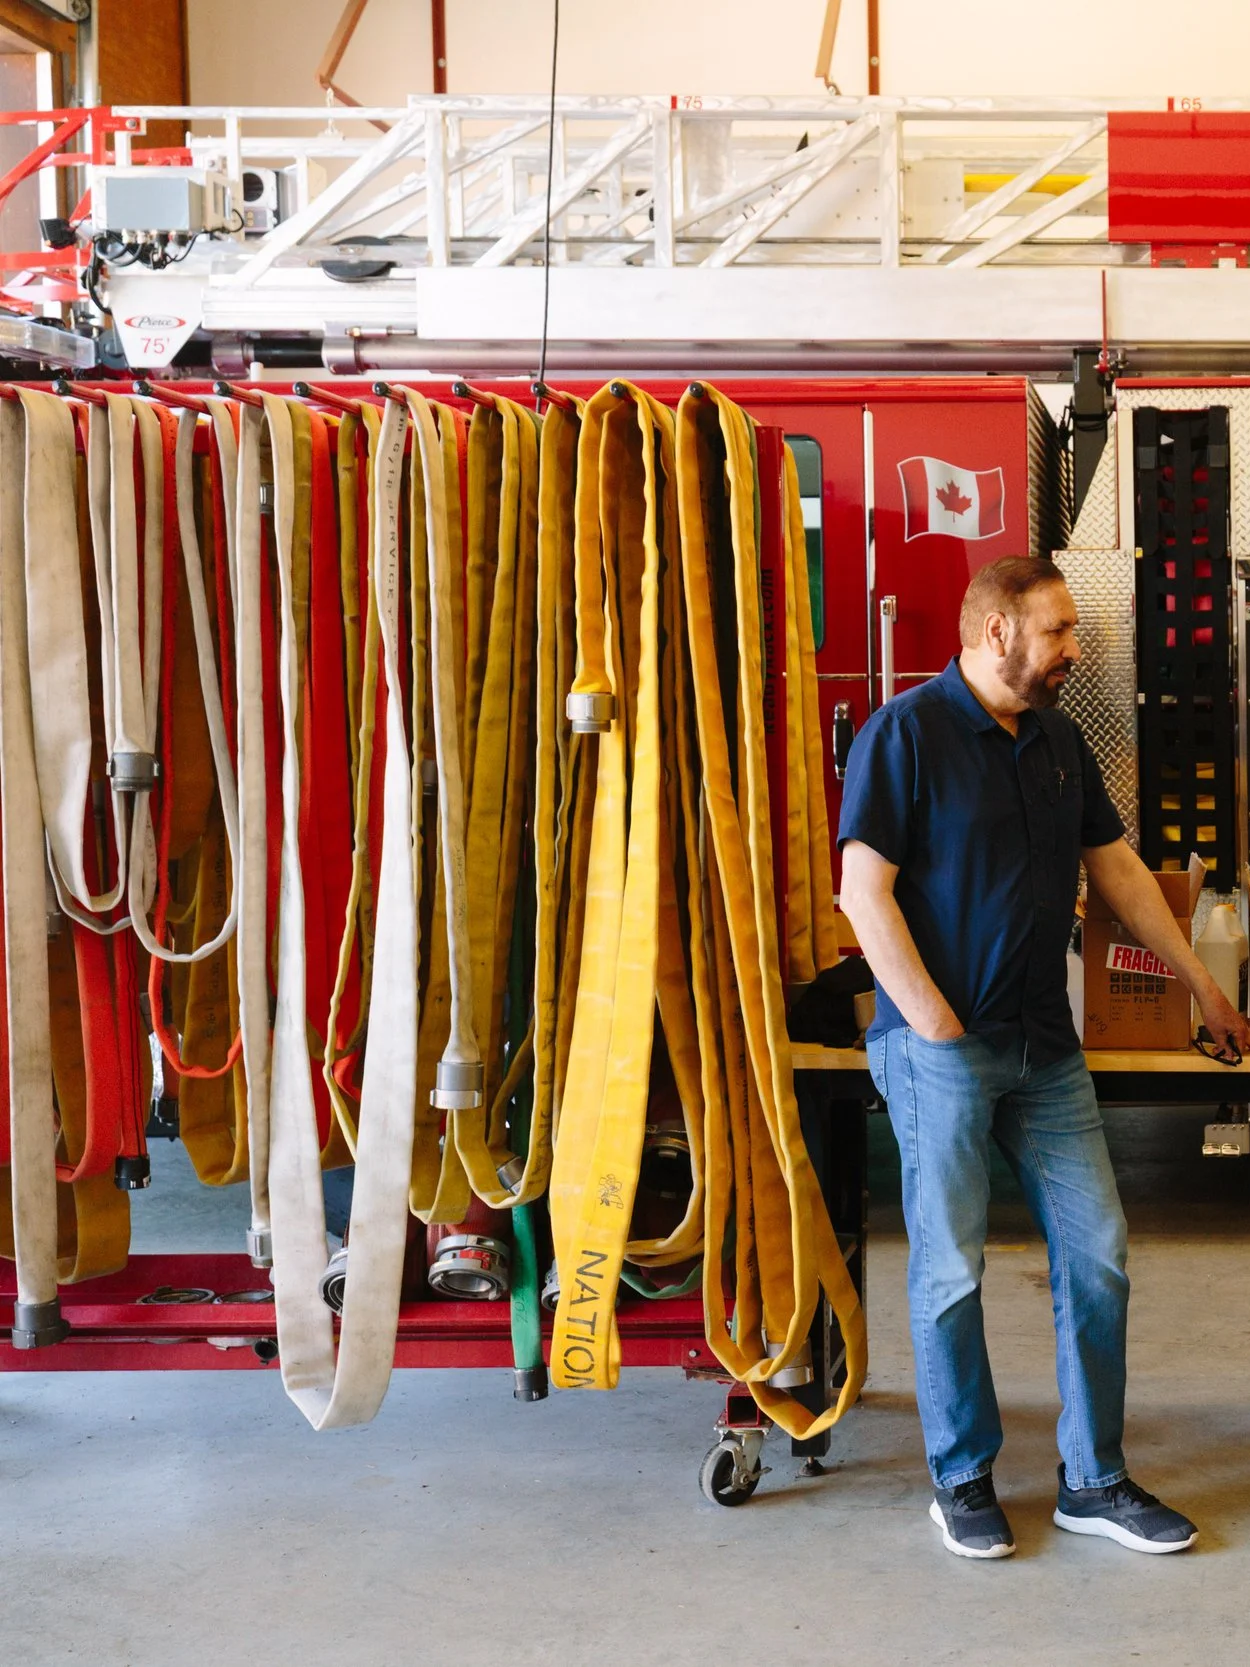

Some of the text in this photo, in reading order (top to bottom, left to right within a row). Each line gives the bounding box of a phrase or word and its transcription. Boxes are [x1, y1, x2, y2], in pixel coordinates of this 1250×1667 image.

[684, 95, 703, 110] 75
[1180, 98, 1202, 111] 65
[138, 315, 173, 327] Pierce
